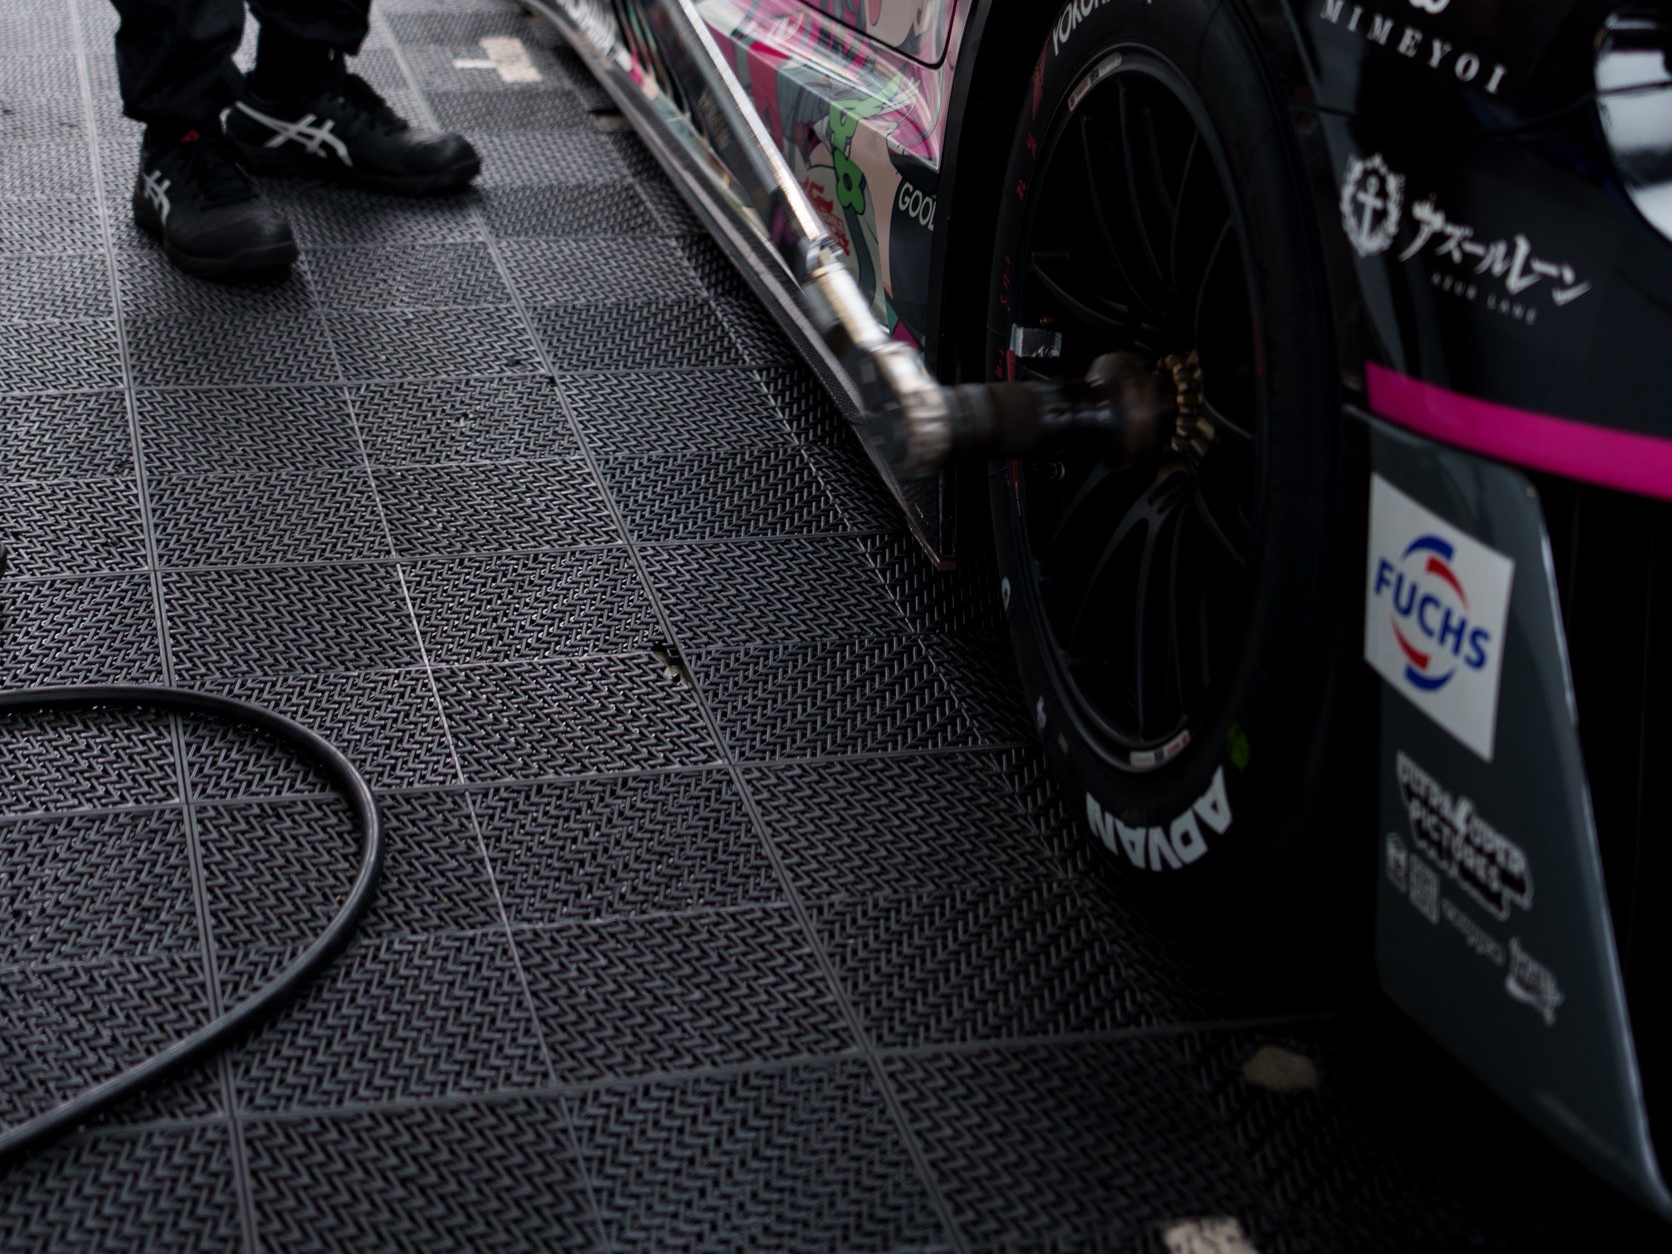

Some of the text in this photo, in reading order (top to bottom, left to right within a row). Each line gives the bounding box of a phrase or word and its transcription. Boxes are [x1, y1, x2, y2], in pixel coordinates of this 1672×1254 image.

[1399, 198, 1593, 307] アズールレーン
[1374, 557, 1491, 672] FUCHS
[1086, 762, 1233, 873] ADVAN
